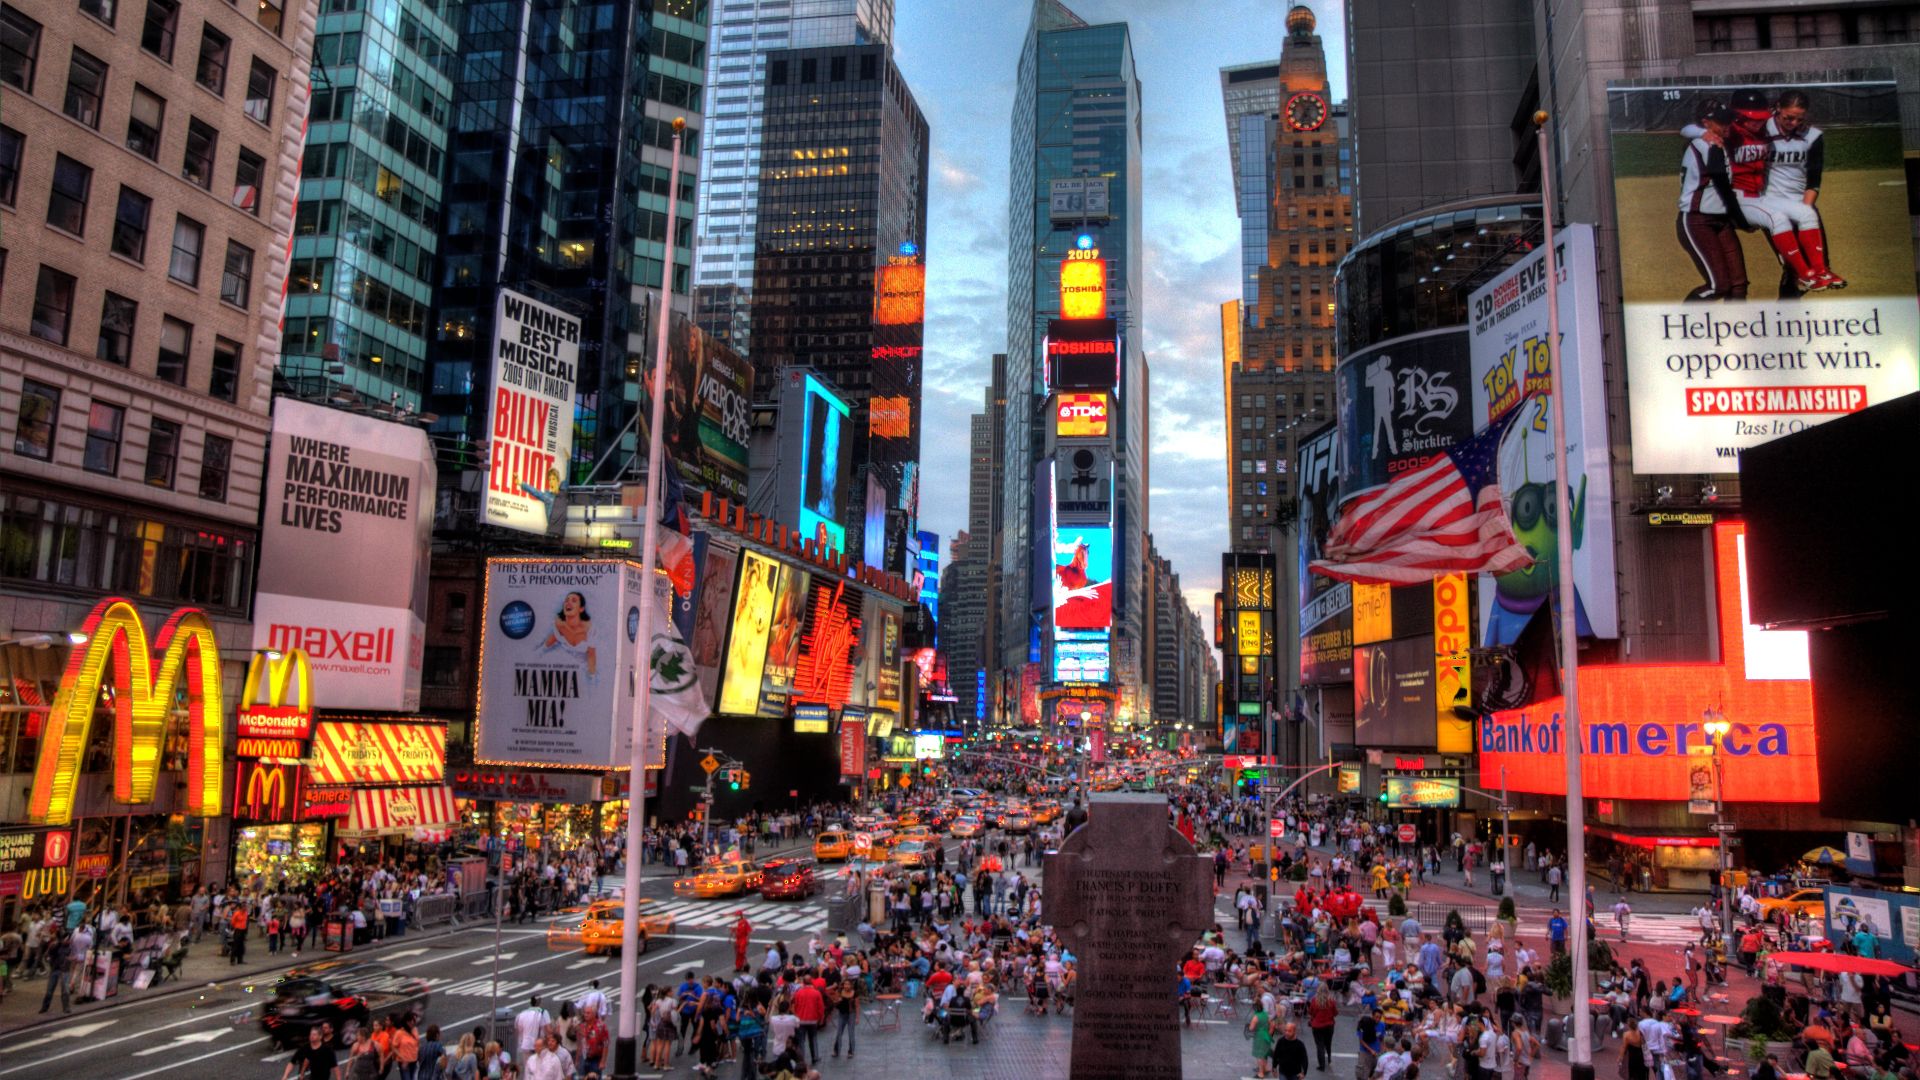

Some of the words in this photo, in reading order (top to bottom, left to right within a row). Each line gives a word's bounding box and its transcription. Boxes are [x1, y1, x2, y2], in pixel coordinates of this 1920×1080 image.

[1663, 90, 1681, 100] 215
[1771, 151, 1807, 163] ENTRA
[1068, 249, 1099, 260] 2009
[1063, 286, 1103, 294] TOSHIBA
[1493, 272, 1518, 297] DOUBLE
[1494, 287, 1519, 309] FEATURE
[503, 294, 580, 345] WINNER
[1475, 293, 1494, 322] 3D
[1476, 322, 1488, 336] ONLY
[1489, 315, 1496, 331] IN
[1496, 301, 1521, 326] THEATRES
[1522, 297, 1527, 309] 2
[520, 325, 562, 357] BEST
[1661, 309, 1767, 347] Helped
[1777, 308, 1883, 344] injured
[499, 338, 575, 383] MUSICAL
[1050, 341, 1115, 355] TOSHIBA
[1666, 349, 1808, 379] opponent
[1812, 342, 1882, 370] win.
[503, 362, 523, 387] 2009
[525, 368, 542, 393] TONY
[543, 375, 569, 401] AWARD
[1483, 344, 1517, 402] TOY
[1525, 377, 1552, 392] STOR
[698, 373, 748, 423] MELROSE
[1070, 405, 1105, 417] TDK
[1397, 366, 1458, 435] RS
[1490, 388, 1518, 420] STORY
[1532, 392, 1548, 433] 2
[1691, 388, 1863, 413] SPORTSMANSHIP
[494, 386, 550, 449] BILLY
[548, 404, 559, 437] MUSICAL
[722, 411, 750, 449] PLACE
[1735, 420, 1768, 436] Pass
[1772, 419, 1785, 435] It
[290, 435, 350, 465] WHERE
[547, 437, 557, 453] THE
[286, 454, 410, 501] MAXIMUM
[489, 438, 555, 501] ELLIOT
[283, 483, 407, 520] PERFORMANCE
[1058, 501, 1109, 511] CHEVROLET
[281, 502, 342, 533] LIVES
[508, 575, 517, 584] IS
[519, 576, 526, 584] A
[520, 564, 573, 575] FEEL-GOOD
[575, 565, 618, 575] MUSICAL
[1326, 584, 1352, 613] BELFORT
[1357, 591, 1388, 621] smile?
[268, 623, 394, 663] maxell
[1241, 627, 1258, 638] LION
[1241, 639, 1259, 649] KING
[1311, 630, 1341, 651] SEPTEMBER
[1343, 628, 1352, 647] 19
[311, 662, 391, 675] ww.maxell.com
[513, 669, 579, 698] MAMMA
[239, 713, 308, 728] McDonald's
[525, 699, 566, 728] MIA!
[249, 726, 295, 736] Restaurant
[1481, 714, 1531, 753] Bank
[1537, 712, 1561, 753] of
[1580, 720, 1790, 756] merica
[455, 772, 549, 787] DIGITAL
[1387, 769, 1460, 778] MARQUIS
[1076, 880, 1125, 892] FRANCIS
[1128, 881, 1135, 893] P
[1140, 881, 1182, 893] DUFFY
